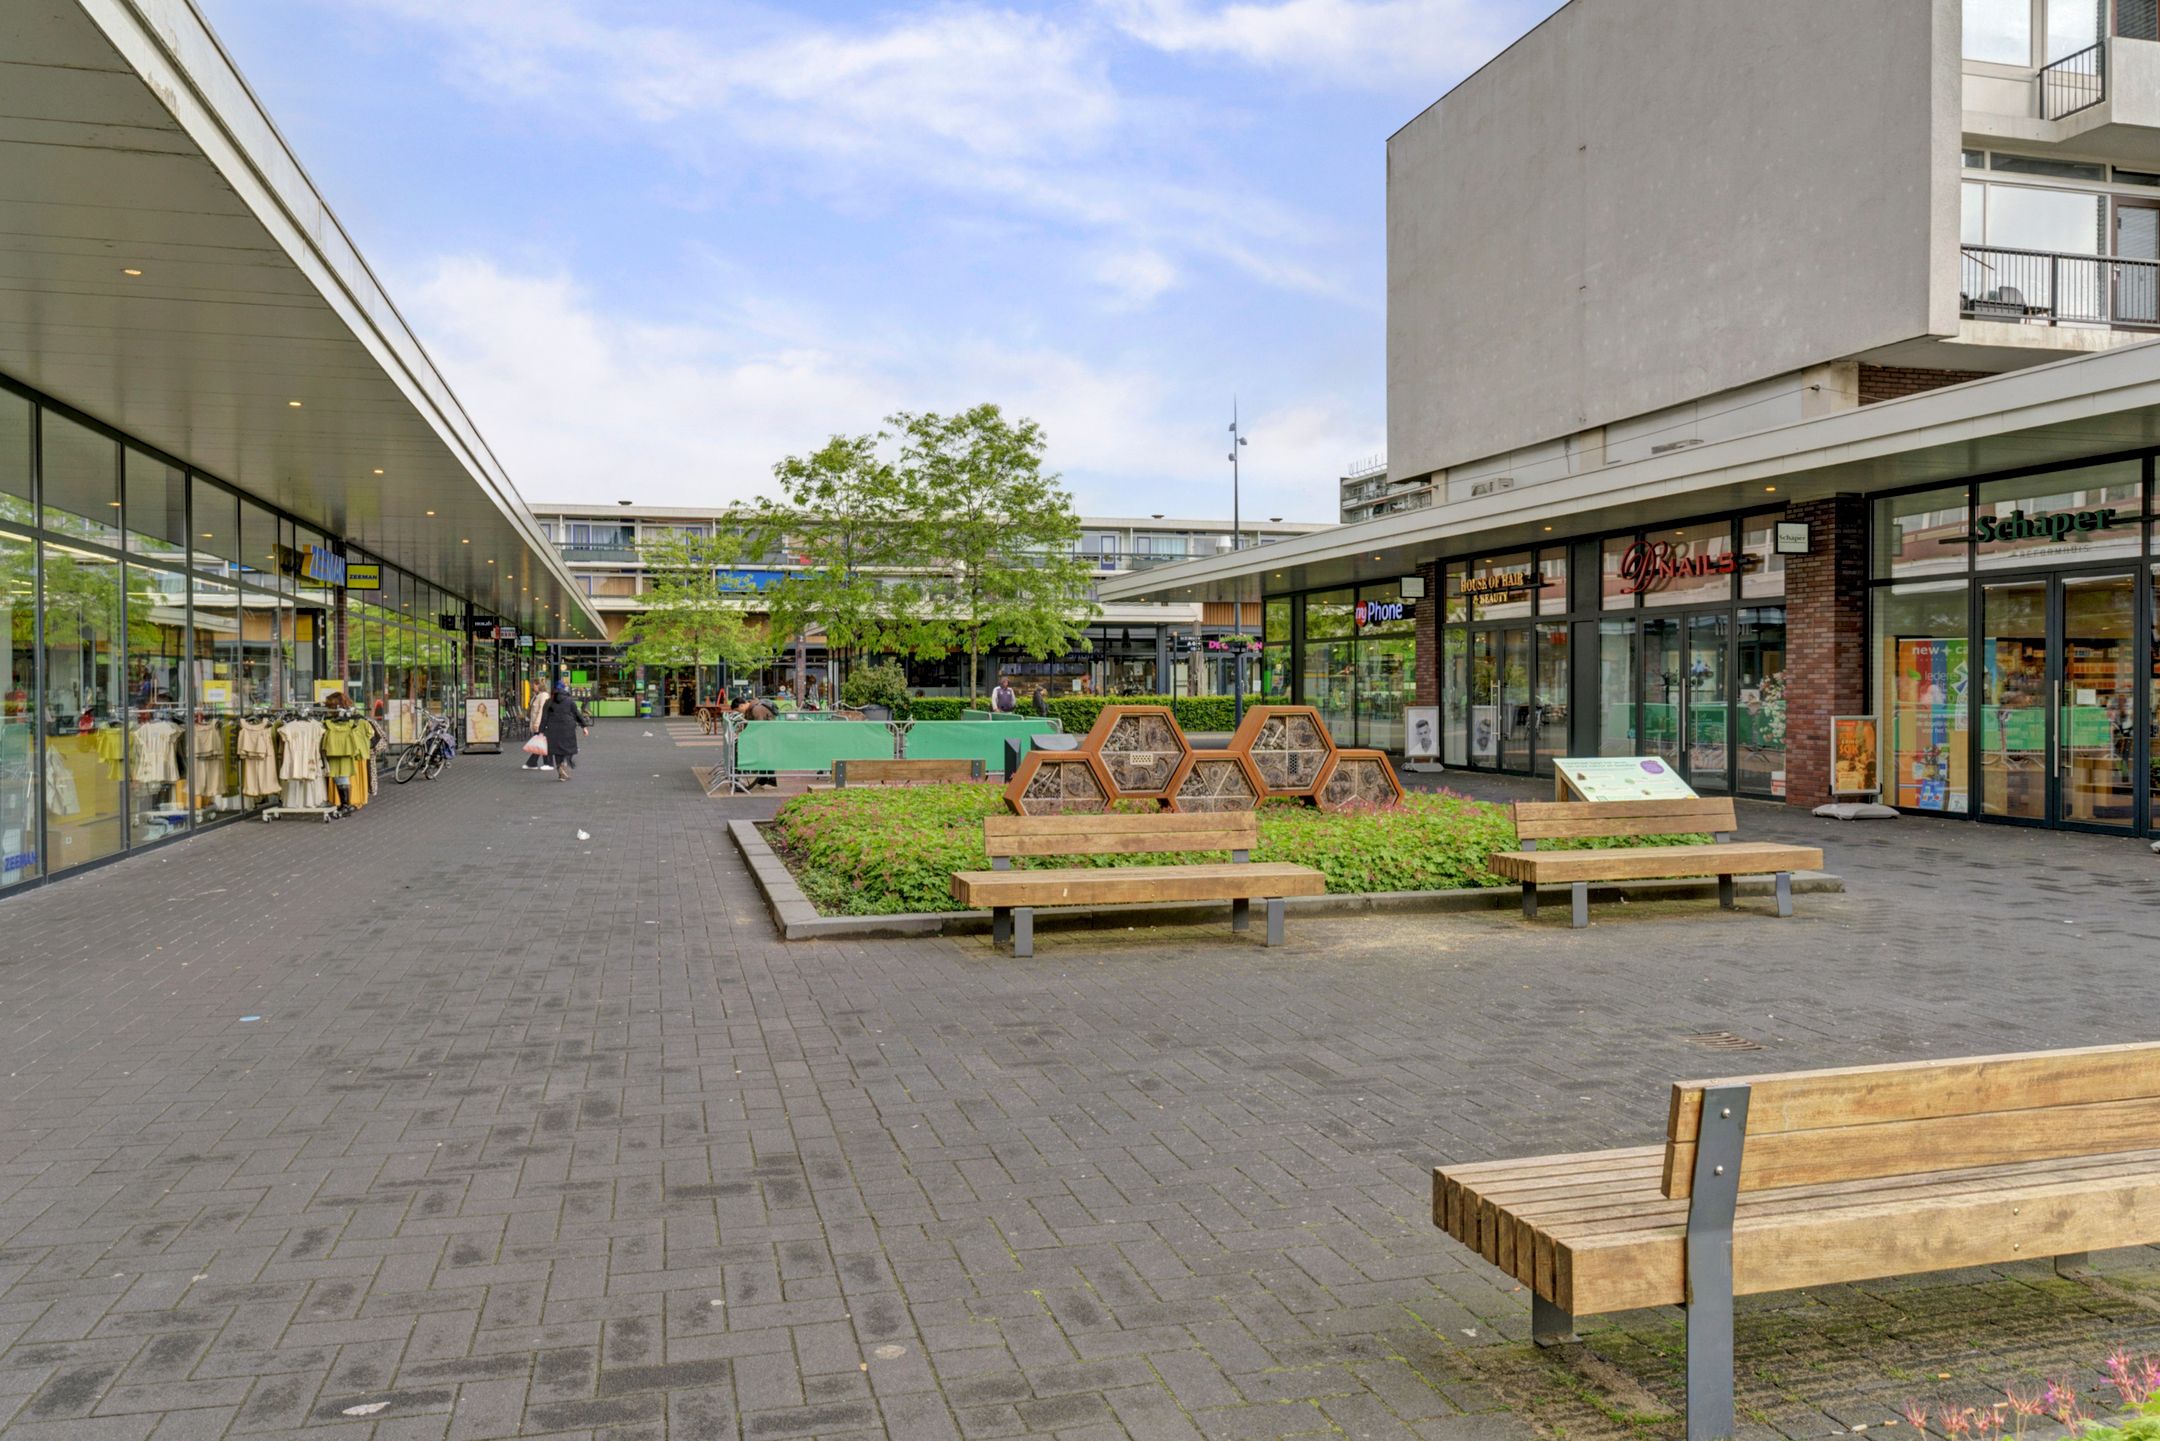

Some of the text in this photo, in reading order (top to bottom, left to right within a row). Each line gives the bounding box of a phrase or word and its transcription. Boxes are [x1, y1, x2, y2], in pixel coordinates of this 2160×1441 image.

[1976, 509, 2116, 542] Schaper
[1779, 534, 1806, 543] Schaper
[310, 545, 346, 587] ZEEMAN
[1659, 552, 1737, 578] NAILS
[1461, 572, 1524, 592] HOUSE OF HAIR
[1479, 591, 1508, 604] BEAUTY
[1355, 600, 1403, 623] myPhone
[1912, 646, 1940, 655] new
[4, 851, 38, 872] ZEEMAN
